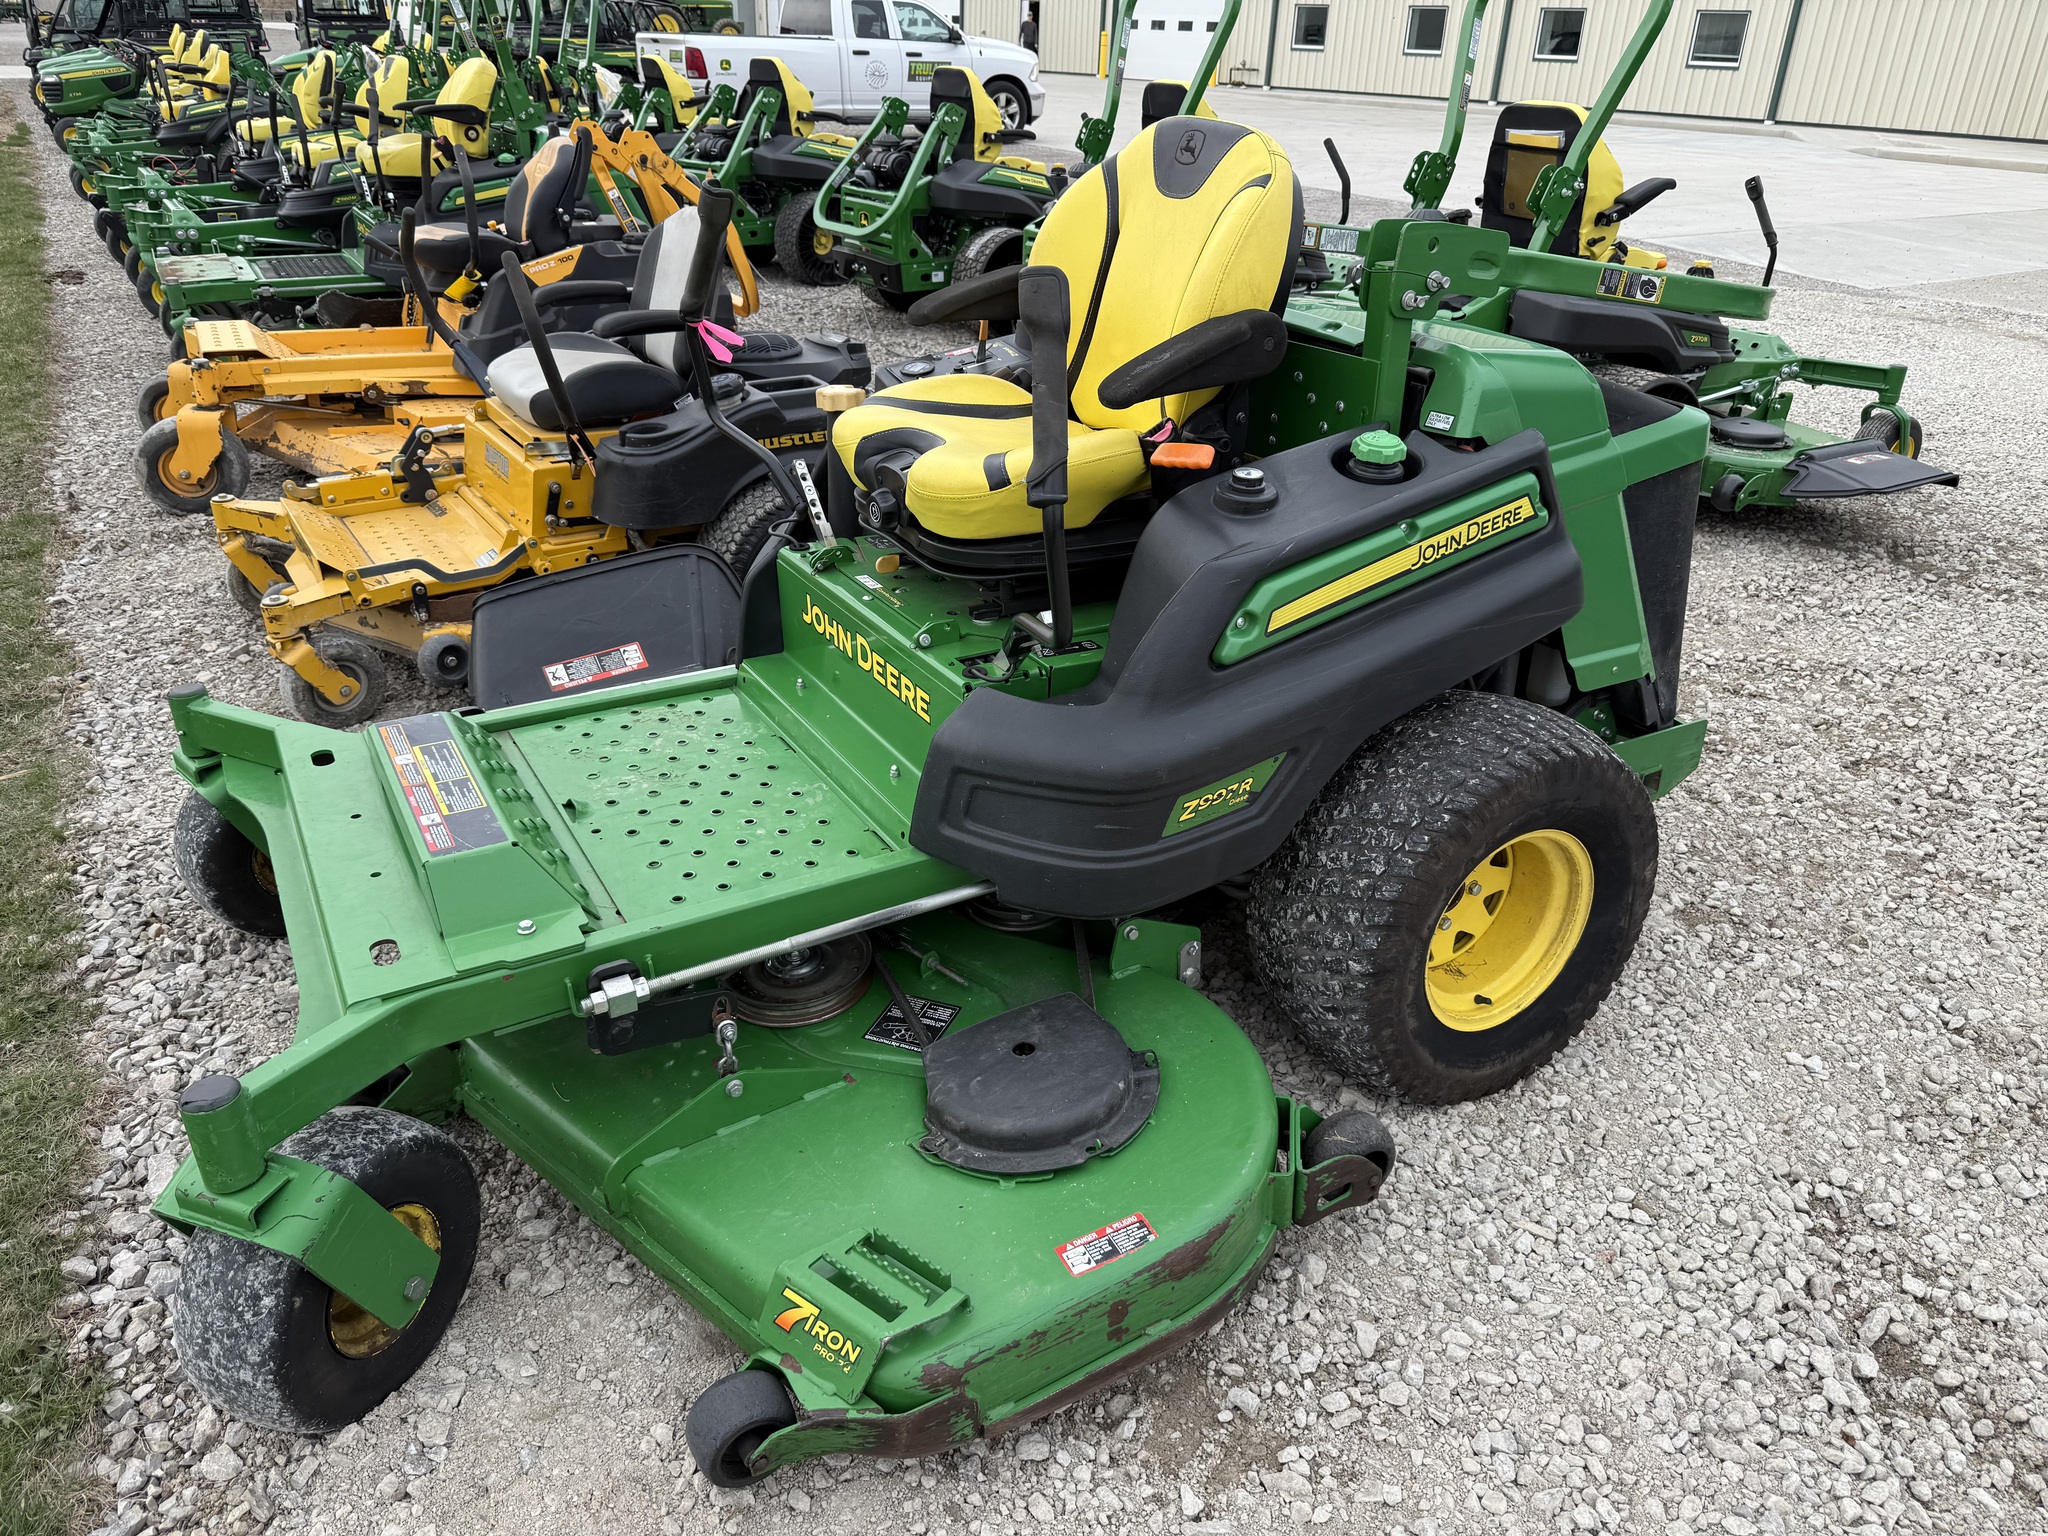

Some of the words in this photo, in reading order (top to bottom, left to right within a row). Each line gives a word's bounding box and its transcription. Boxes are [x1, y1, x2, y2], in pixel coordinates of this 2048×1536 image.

[529, 263, 549, 274] PRO
[558, 254, 574, 264] 100
[758, 431, 827, 449] USTLE
[1410, 531, 1462, 569] JOHN
[1466, 505, 1523, 543] DEERE
[802, 593, 853, 660] JOHN
[856, 633, 931, 725] DEERE
[1178, 777, 1254, 822] Z997R
[1229, 794, 1249, 806] Diese
[1073, 1232, 1098, 1246] DANGER
[1112, 1216, 1138, 1230] PELIGRO
[774, 1286, 821, 1334] 7
[803, 1313, 862, 1364] IRON
[813, 1343, 835, 1362] PRO
